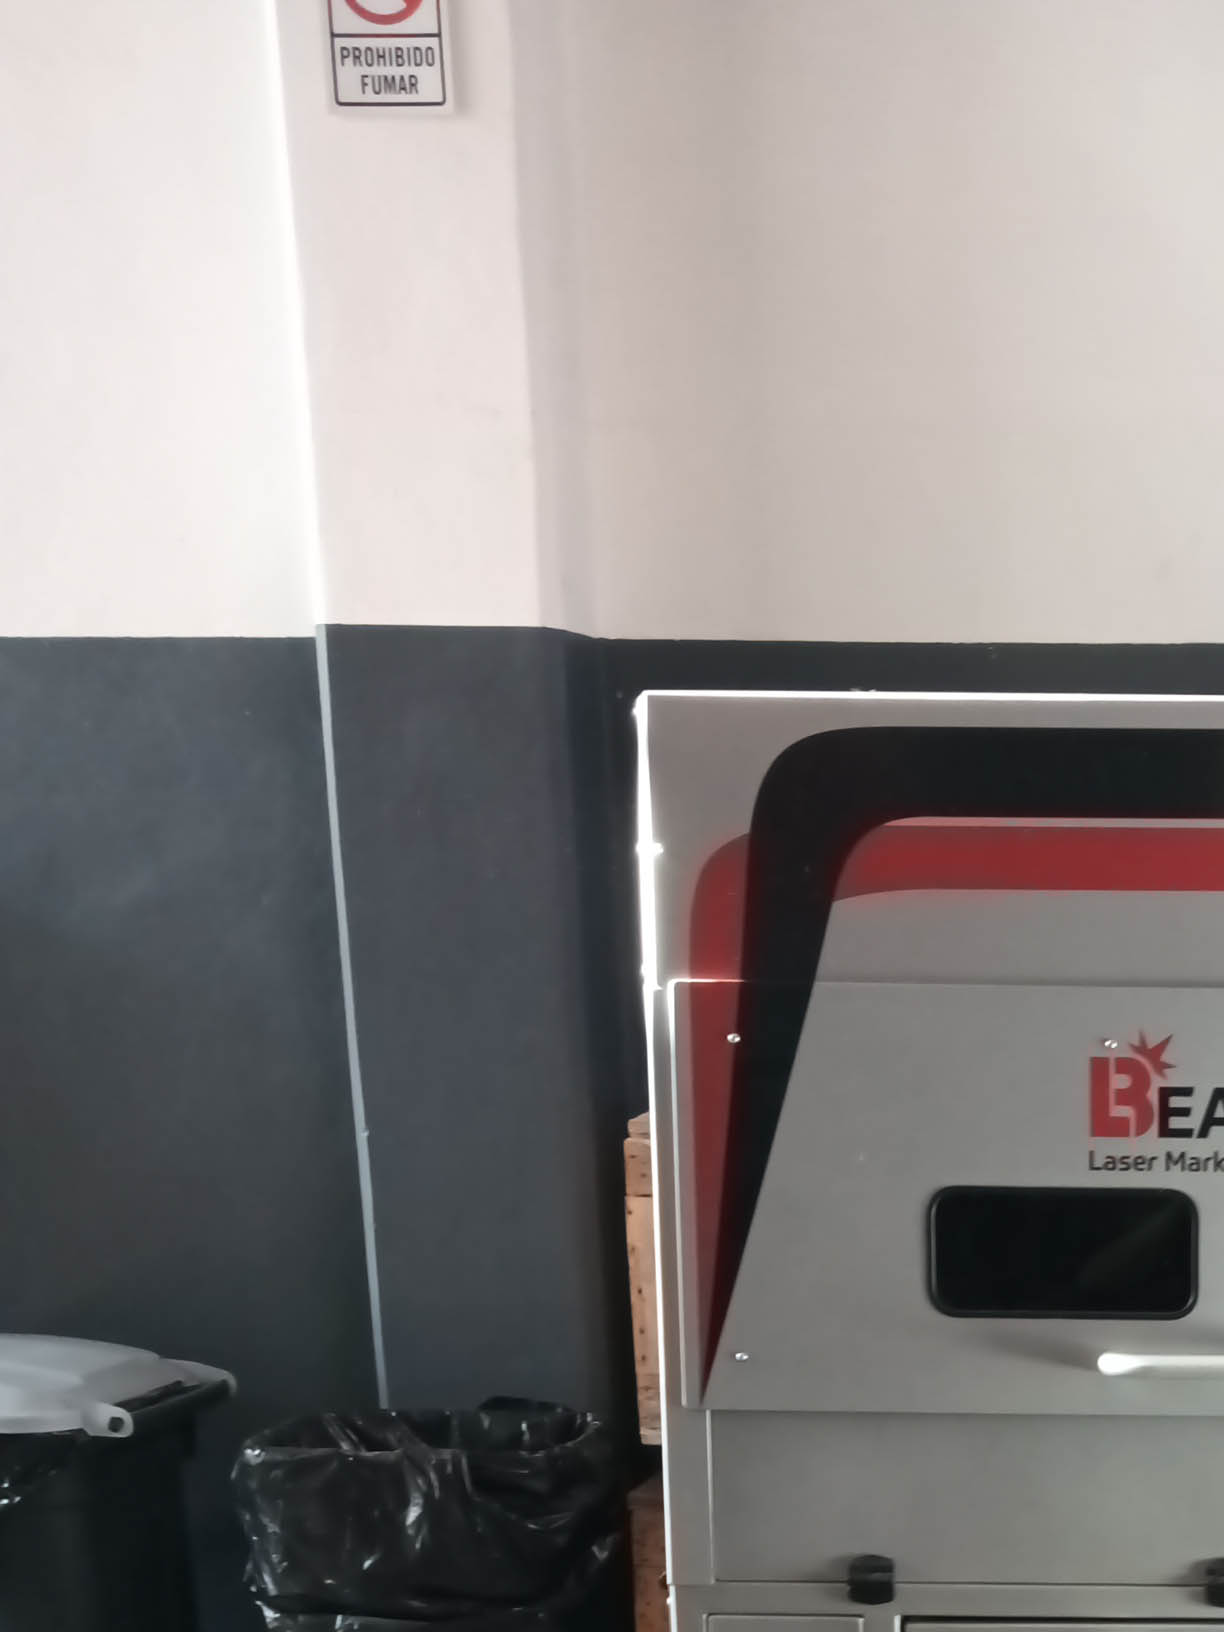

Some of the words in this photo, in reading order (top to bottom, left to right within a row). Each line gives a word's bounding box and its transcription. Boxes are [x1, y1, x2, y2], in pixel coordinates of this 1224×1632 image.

[339, 46, 436, 67] PROHIBIDO
[360, 74, 419, 95] FUMAR
[1088, 1150, 1158, 1171] Laser
